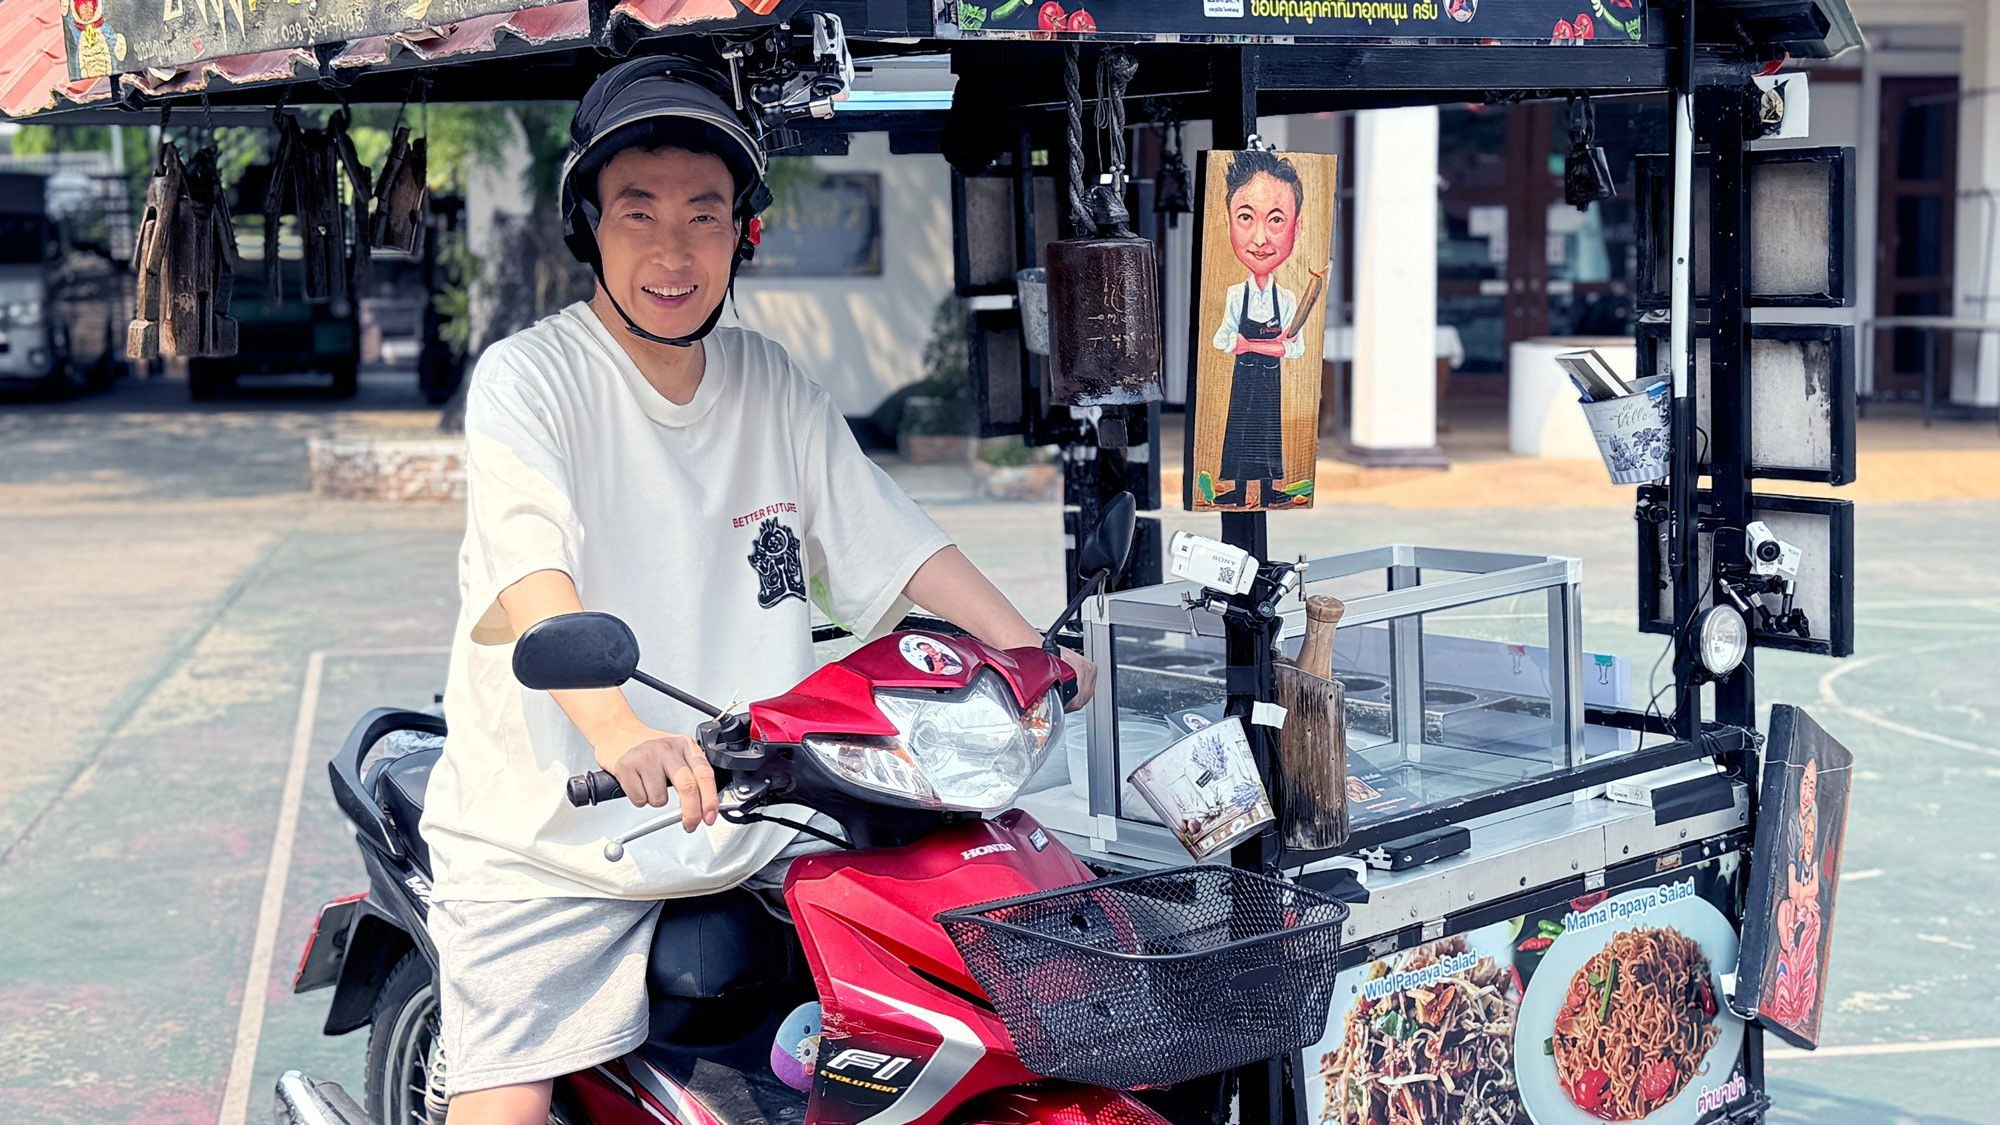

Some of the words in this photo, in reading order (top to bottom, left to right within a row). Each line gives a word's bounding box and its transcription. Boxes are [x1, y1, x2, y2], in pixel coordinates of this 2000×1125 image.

[1251, 0, 1408, 25] ขอบคุณลูกคาทมาอุดหนุน
[1609, 407, 1651, 429] Ville
[732, 508, 766, 529] BETTER
[1211, 555, 1237, 567] SONY
[960, 842, 1018, 861] HONDA
[1566, 908, 1607, 933] Mama
[1609, 893, 1657, 919] Papaya
[1658, 880, 1694, 905] Salad
[1364, 976, 1393, 999] Wild
[1395, 964, 1441, 990] Papaya
[1443, 951, 1477, 974] Salad
[826, 1048, 913, 1081] FI
[820, 1068, 899, 1094] EVOLUTION
